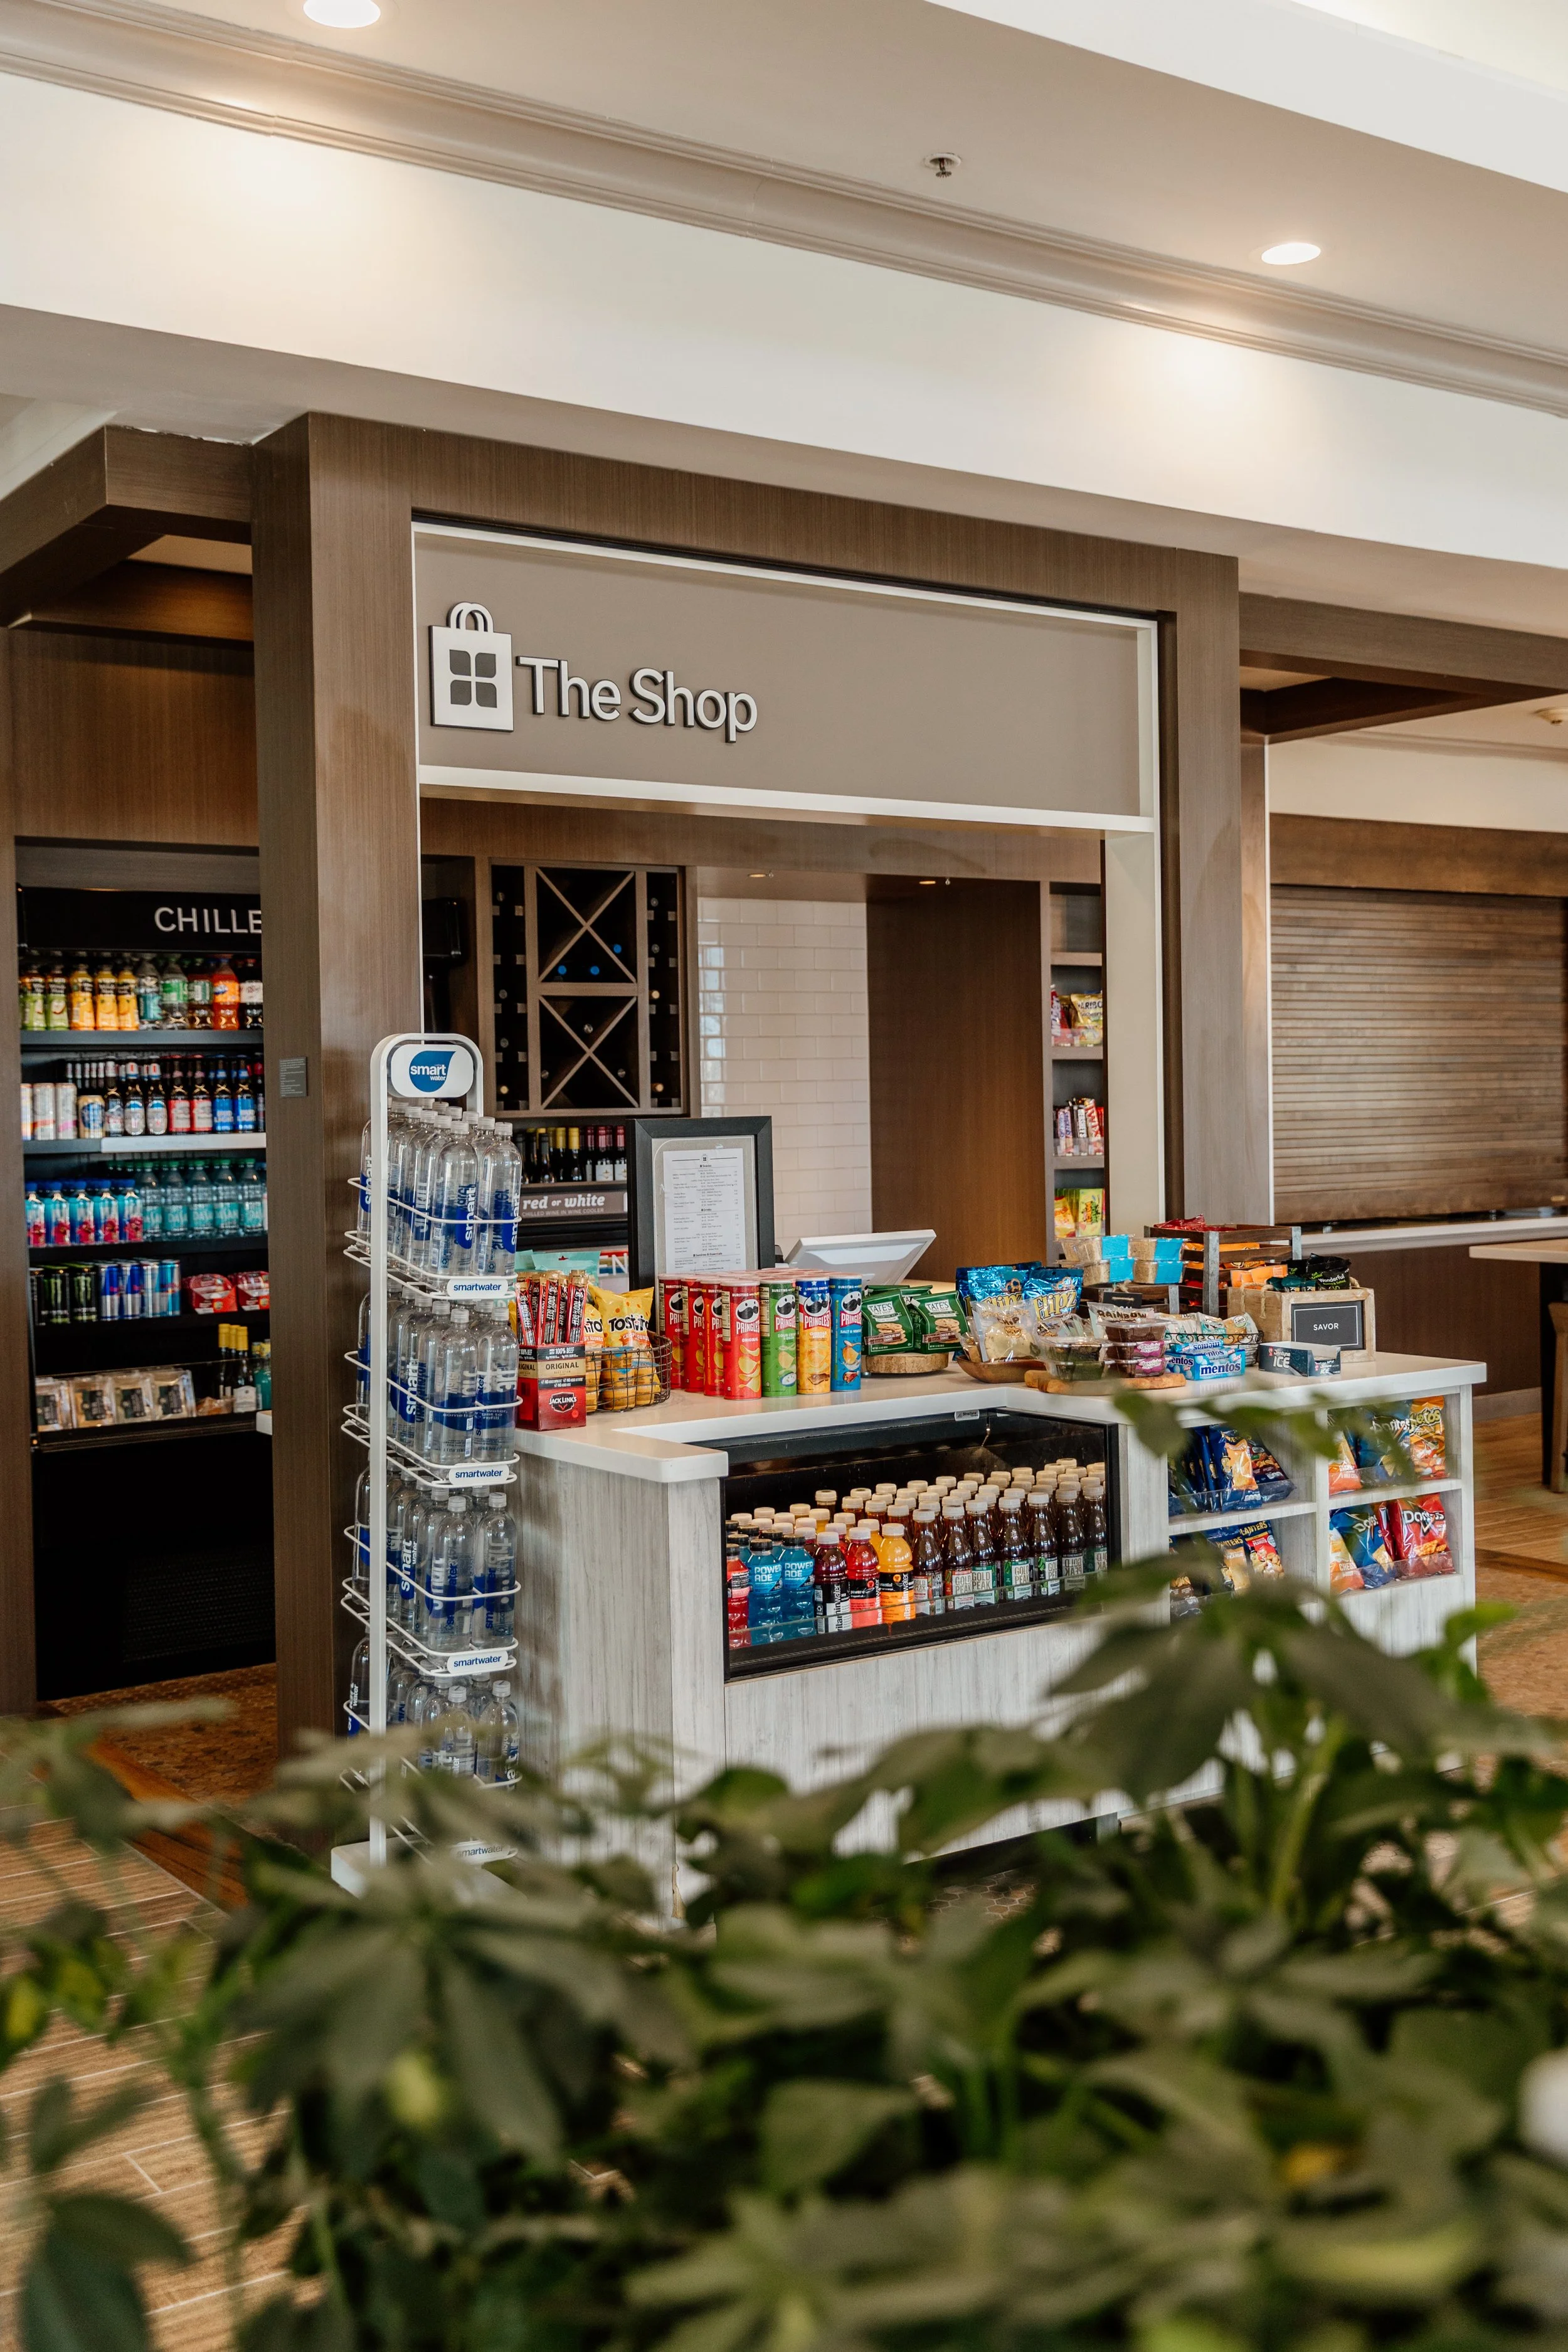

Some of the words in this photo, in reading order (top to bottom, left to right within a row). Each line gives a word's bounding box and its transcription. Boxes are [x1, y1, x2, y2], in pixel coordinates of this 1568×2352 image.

[516, 655, 622, 721] The
[628, 667, 758, 743] Shop
[410, 1064, 447, 1076] smart
[522, 1195, 549, 1210] red
[564, 1193, 606, 1207] white
[1318, 1273, 1345, 1283] Wonderful
[453, 1283, 502, 1291] smartwater
[869, 1303, 893, 1314] TATE'S
[926, 1301, 949, 1311] TATE'S
[1034, 1290, 1078, 1320] Flipz
[1097, 1309, 1147, 1319] RAINBOW
[804, 1313, 830, 1329] PRINGLES
[736, 1320, 760, 1335] PRINGLES
[1313, 1323, 1339, 1331] SAVOR
[1193, 1341, 1221, 1350] mentos
[1273, 1348, 1291, 1357] Dentyne
[546, 1362, 579, 1370] ORIGINAL
[1273, 1355, 1291, 1369] ICE
[1200, 1362, 1241, 1375] mentos
[455, 1468, 503, 1479] smartwater
[1402, 1510, 1444, 1524] Doritos
[755, 1564, 782, 1574] POWER
[785, 1561, 813, 1570] POWER
[755, 1574, 773, 1582] ADE
[955, 1575, 972, 1586] GOLD
[972, 1571, 990, 1582] GOLD
[955, 1584, 972, 1595] PEAK
[972, 1580, 991, 1590] PEAK
[454, 1655, 502, 1667] smartwater
